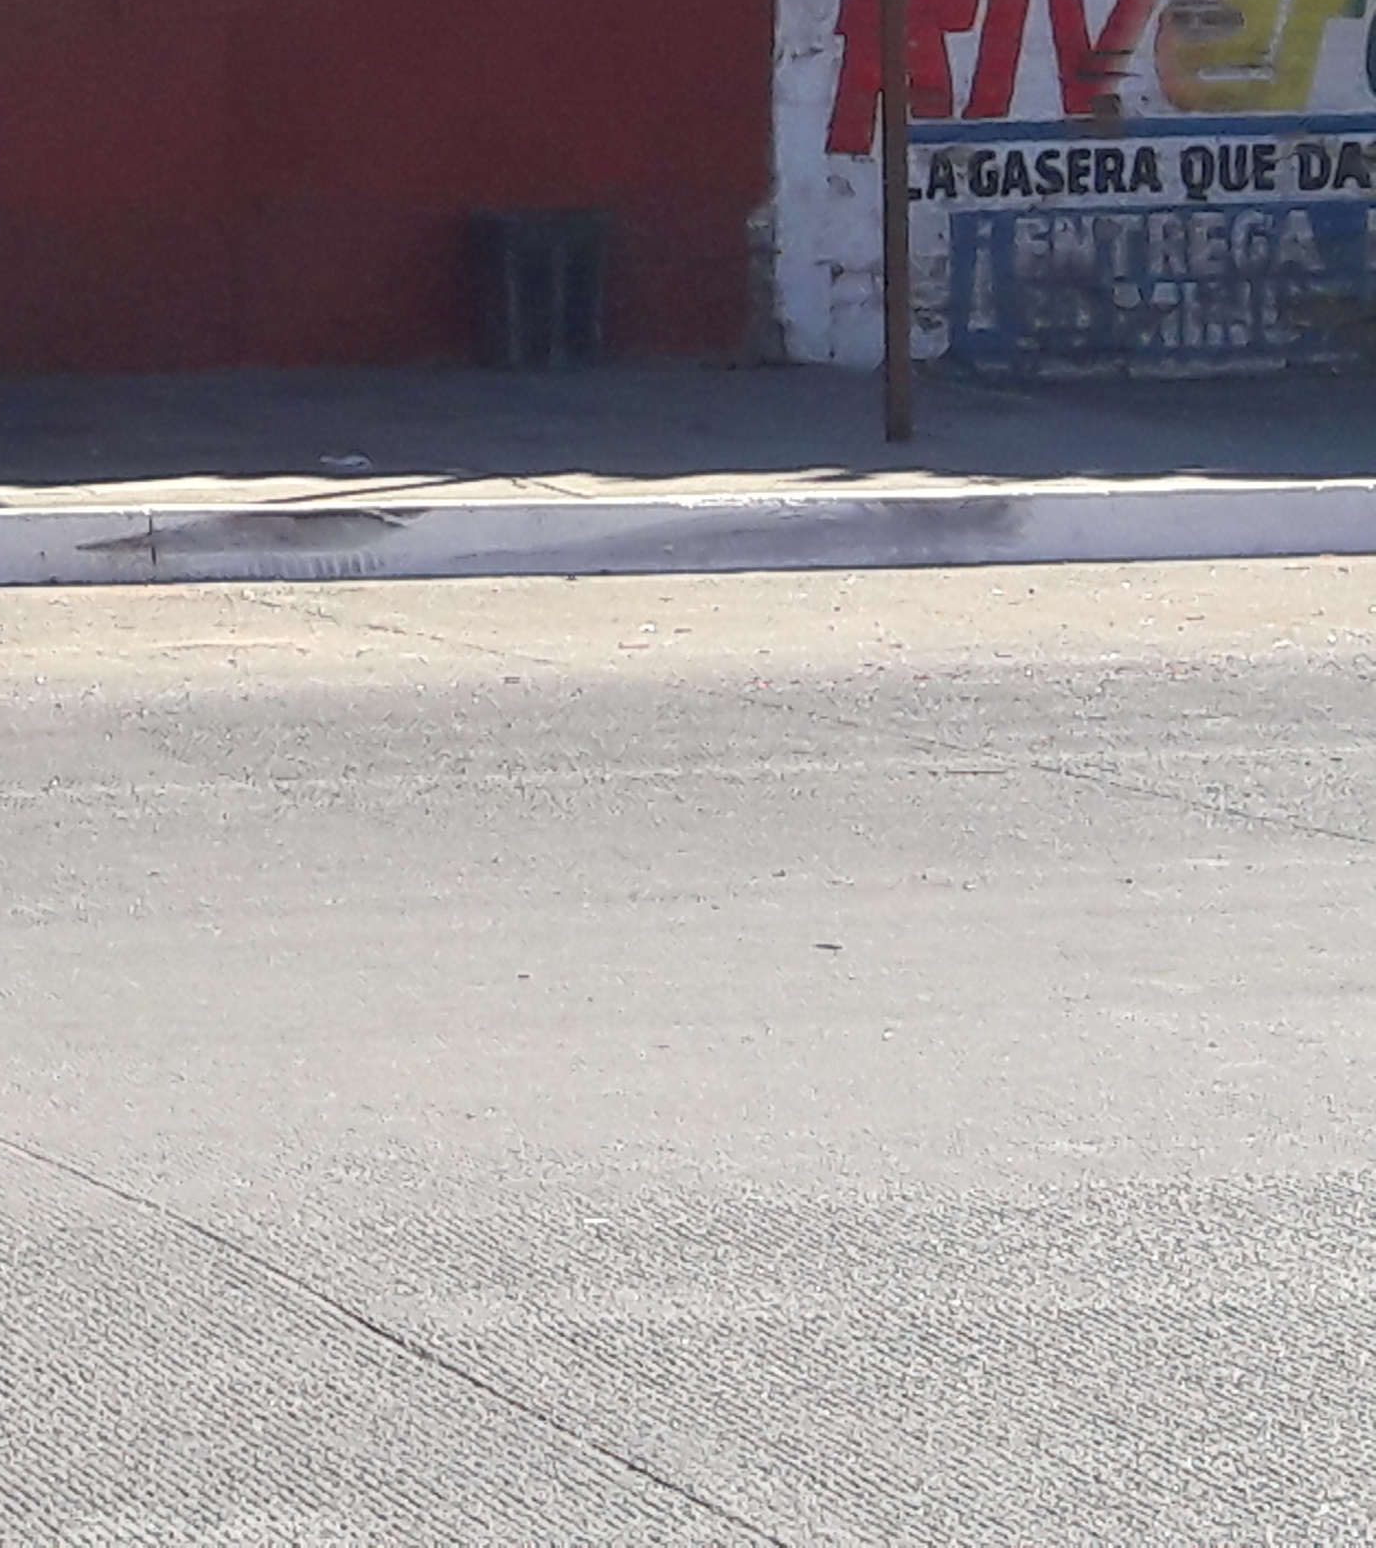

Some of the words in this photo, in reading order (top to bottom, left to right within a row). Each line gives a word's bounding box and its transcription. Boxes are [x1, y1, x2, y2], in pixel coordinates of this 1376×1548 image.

[966, 144, 1164, 199] GASERA
[1180, 142, 1279, 202] QUE
[1295, 139, 1374, 192] DA
